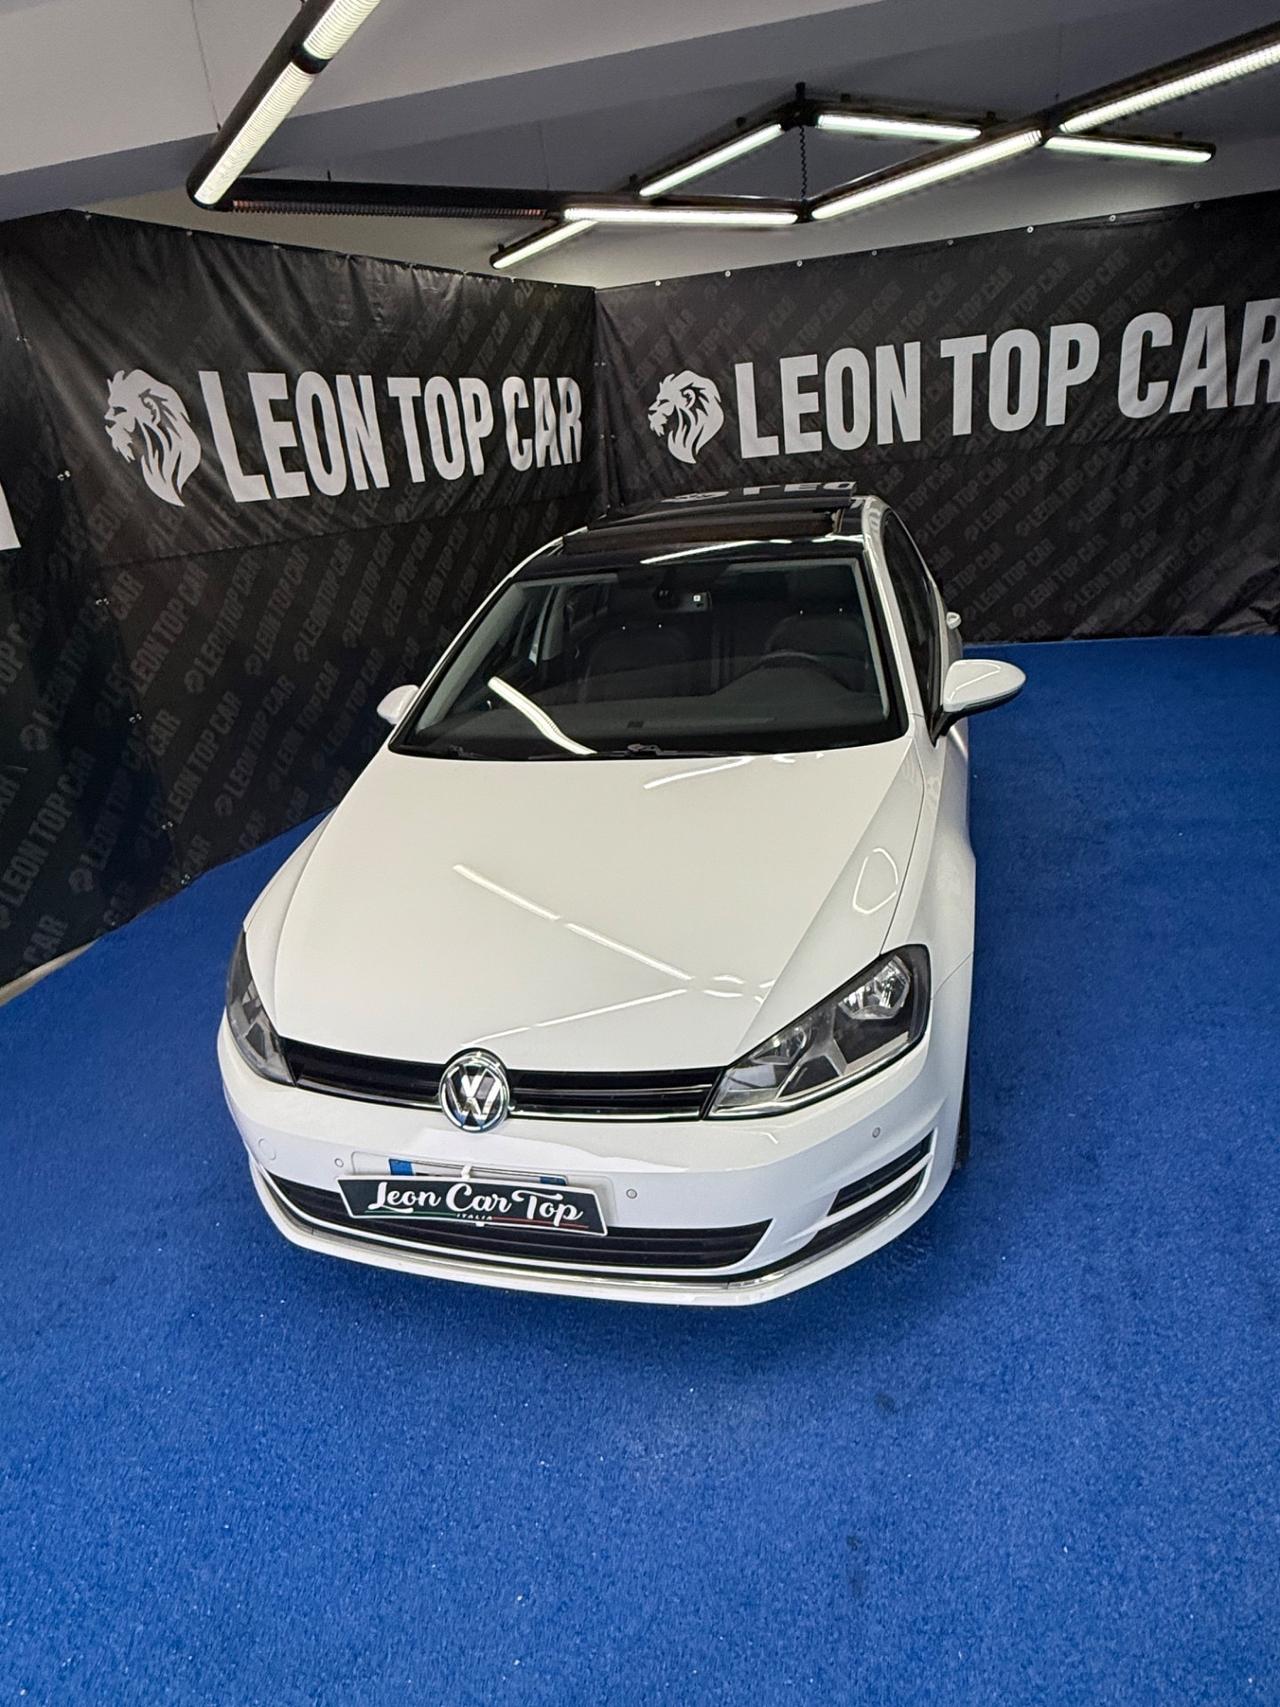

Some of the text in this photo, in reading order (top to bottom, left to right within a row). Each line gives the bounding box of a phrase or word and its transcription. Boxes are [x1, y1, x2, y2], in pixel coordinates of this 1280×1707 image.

[734, 340, 921, 459] LEON
[940, 321, 1100, 436] TOP
[1117, 297, 1280, 419] CAR
[198, 370, 583, 502] LEON TOP CAR
[1025, 537, 1057, 568] CAR
[152, 597, 189, 644] TOP
[187, 728, 220, 772] TOP
[0, 838, 49, 909] LEON
[28, 792, 73, 844] TOP
[368, 1181, 584, 1227] Leon Car Top
